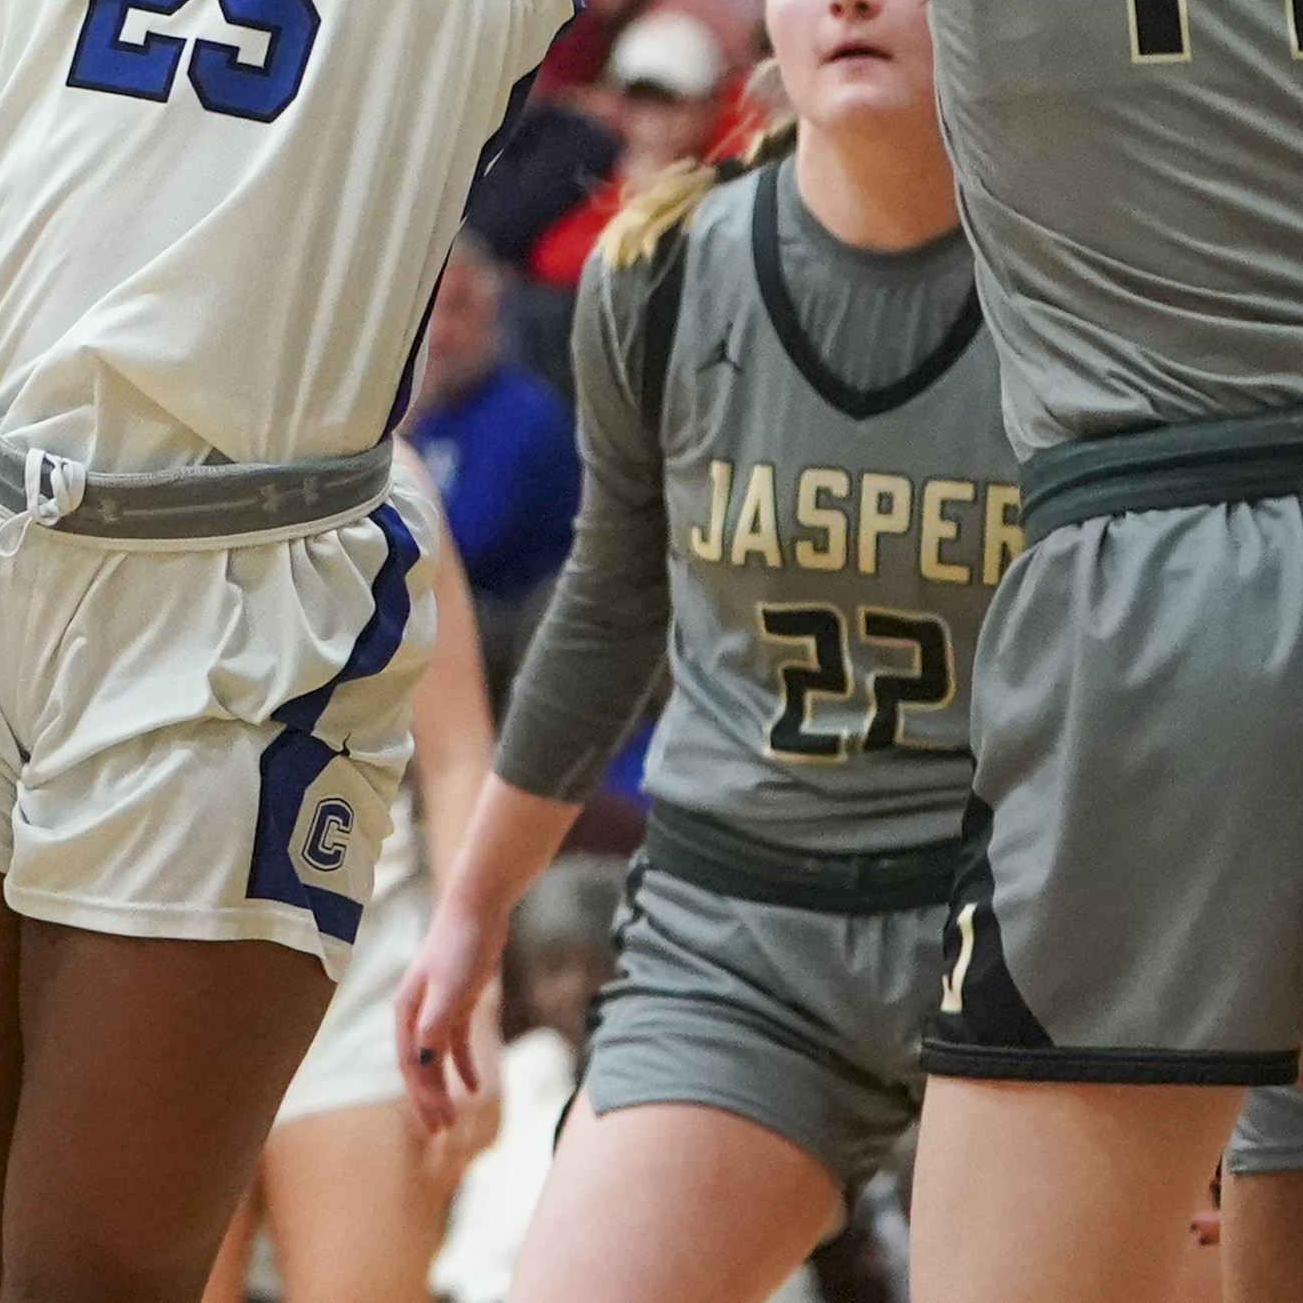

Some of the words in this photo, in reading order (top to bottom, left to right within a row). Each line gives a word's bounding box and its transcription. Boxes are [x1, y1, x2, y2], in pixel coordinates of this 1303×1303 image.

[689, 460, 1025, 587] JASPER
[757, 602, 962, 764] 22
[301, 797, 355, 872] C
